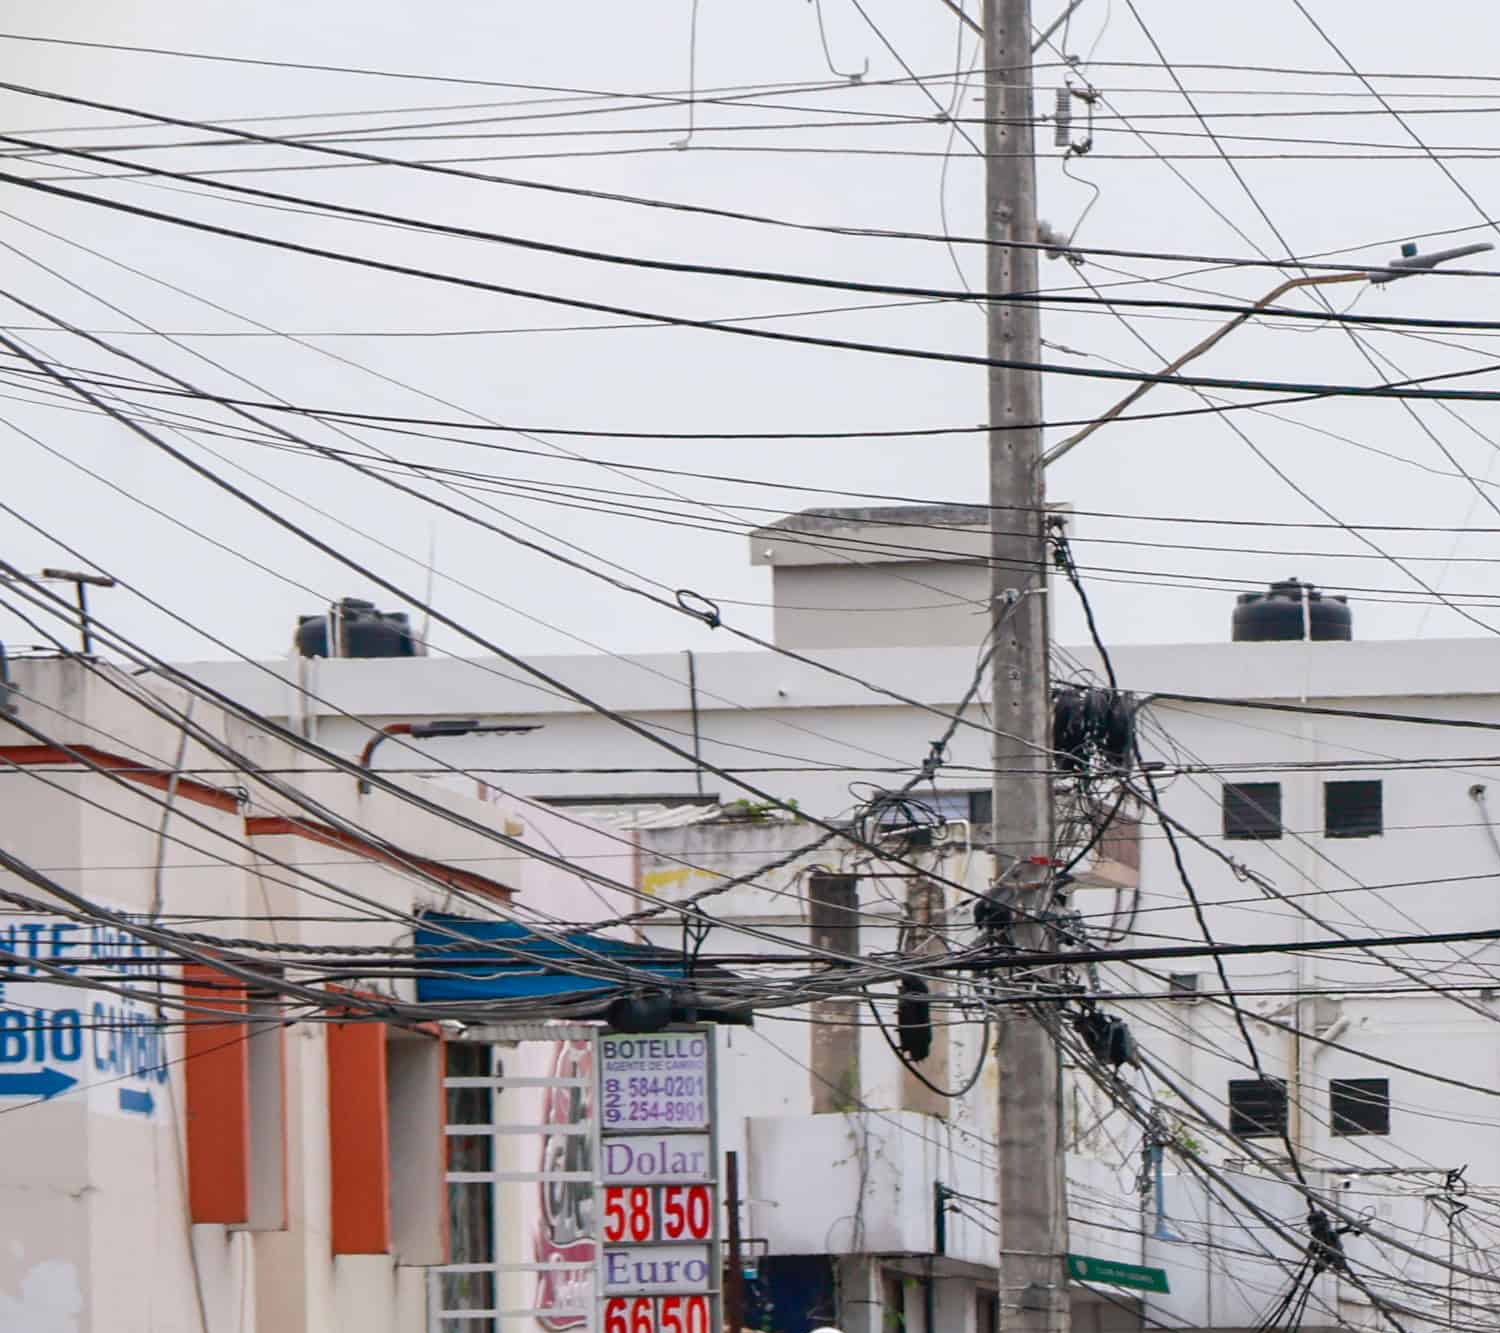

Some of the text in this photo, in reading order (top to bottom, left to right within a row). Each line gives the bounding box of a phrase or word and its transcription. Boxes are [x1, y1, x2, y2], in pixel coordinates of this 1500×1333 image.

[603, 1039, 705, 1059] BOTELLO
[649, 1060, 665, 1071] DE
[628, 1076, 704, 1097] 584-0201
[628, 1100, 704, 1121] 254-8901
[605, 1140, 704, 1176] Dolar
[604, 1251, 710, 1285] Euro
